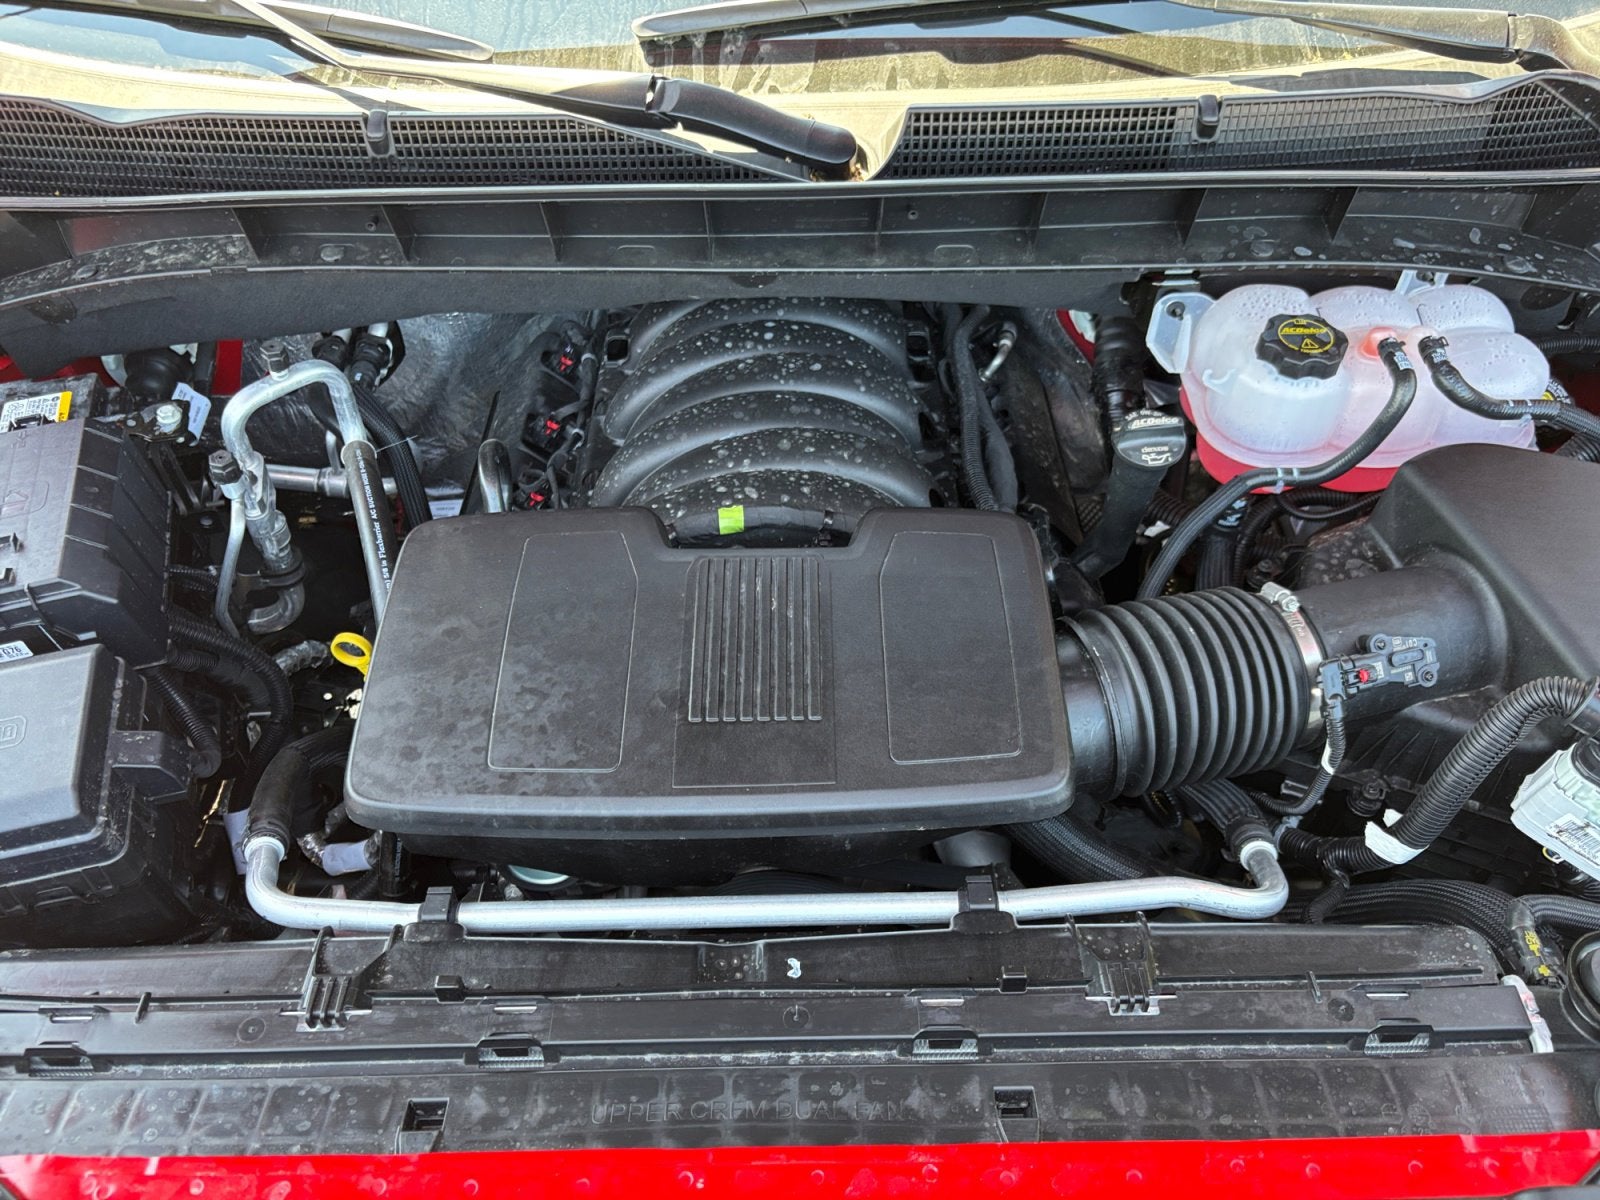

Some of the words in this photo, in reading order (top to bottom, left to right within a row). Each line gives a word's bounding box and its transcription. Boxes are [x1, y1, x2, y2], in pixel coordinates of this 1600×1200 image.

[1281, 327, 1327, 335] ACDelco
[1131, 417, 1179, 430] ACDelco
[373, 521, 386, 559] Flexbarrier
[592, 1102, 682, 1124] UPPER
[776, 1100, 848, 1120] DUAL
